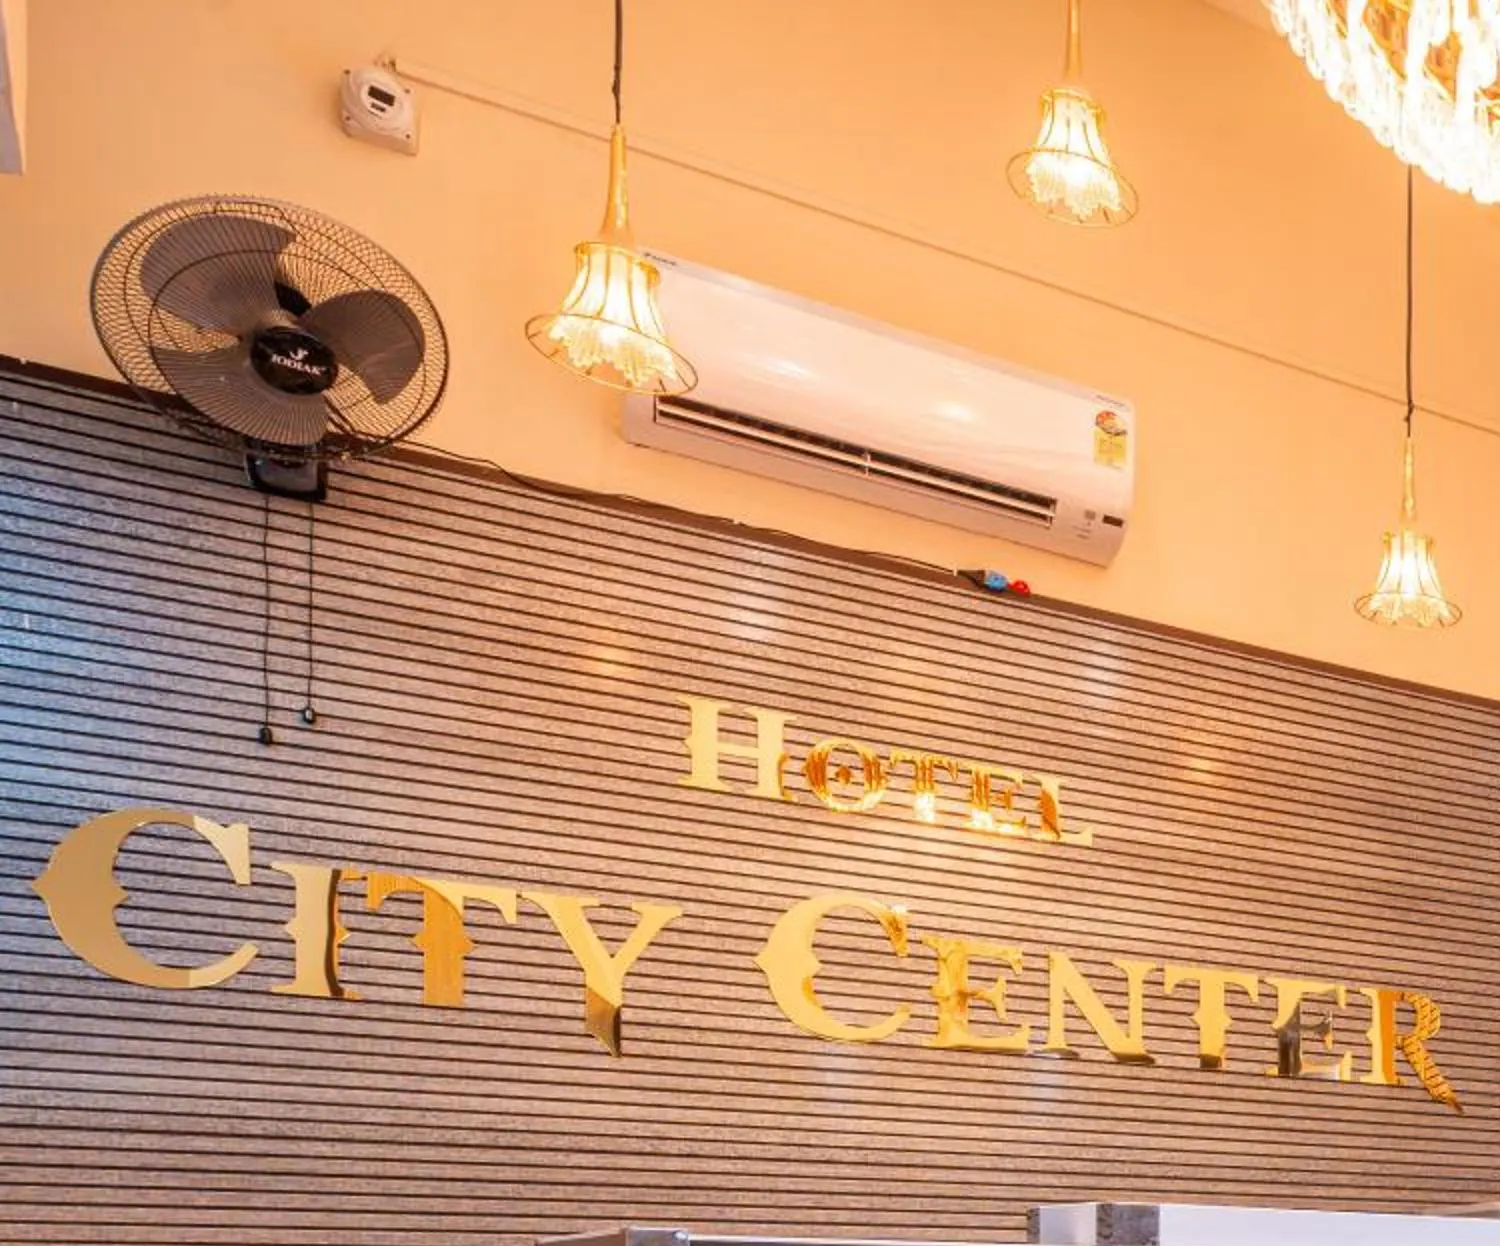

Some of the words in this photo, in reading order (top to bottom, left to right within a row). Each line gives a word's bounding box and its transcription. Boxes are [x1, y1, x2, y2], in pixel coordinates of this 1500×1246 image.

[677, 693, 1094, 848] HOTEL
[31, 808, 683, 1058] CITY
[754, 892, 1463, 1114] CENTER
